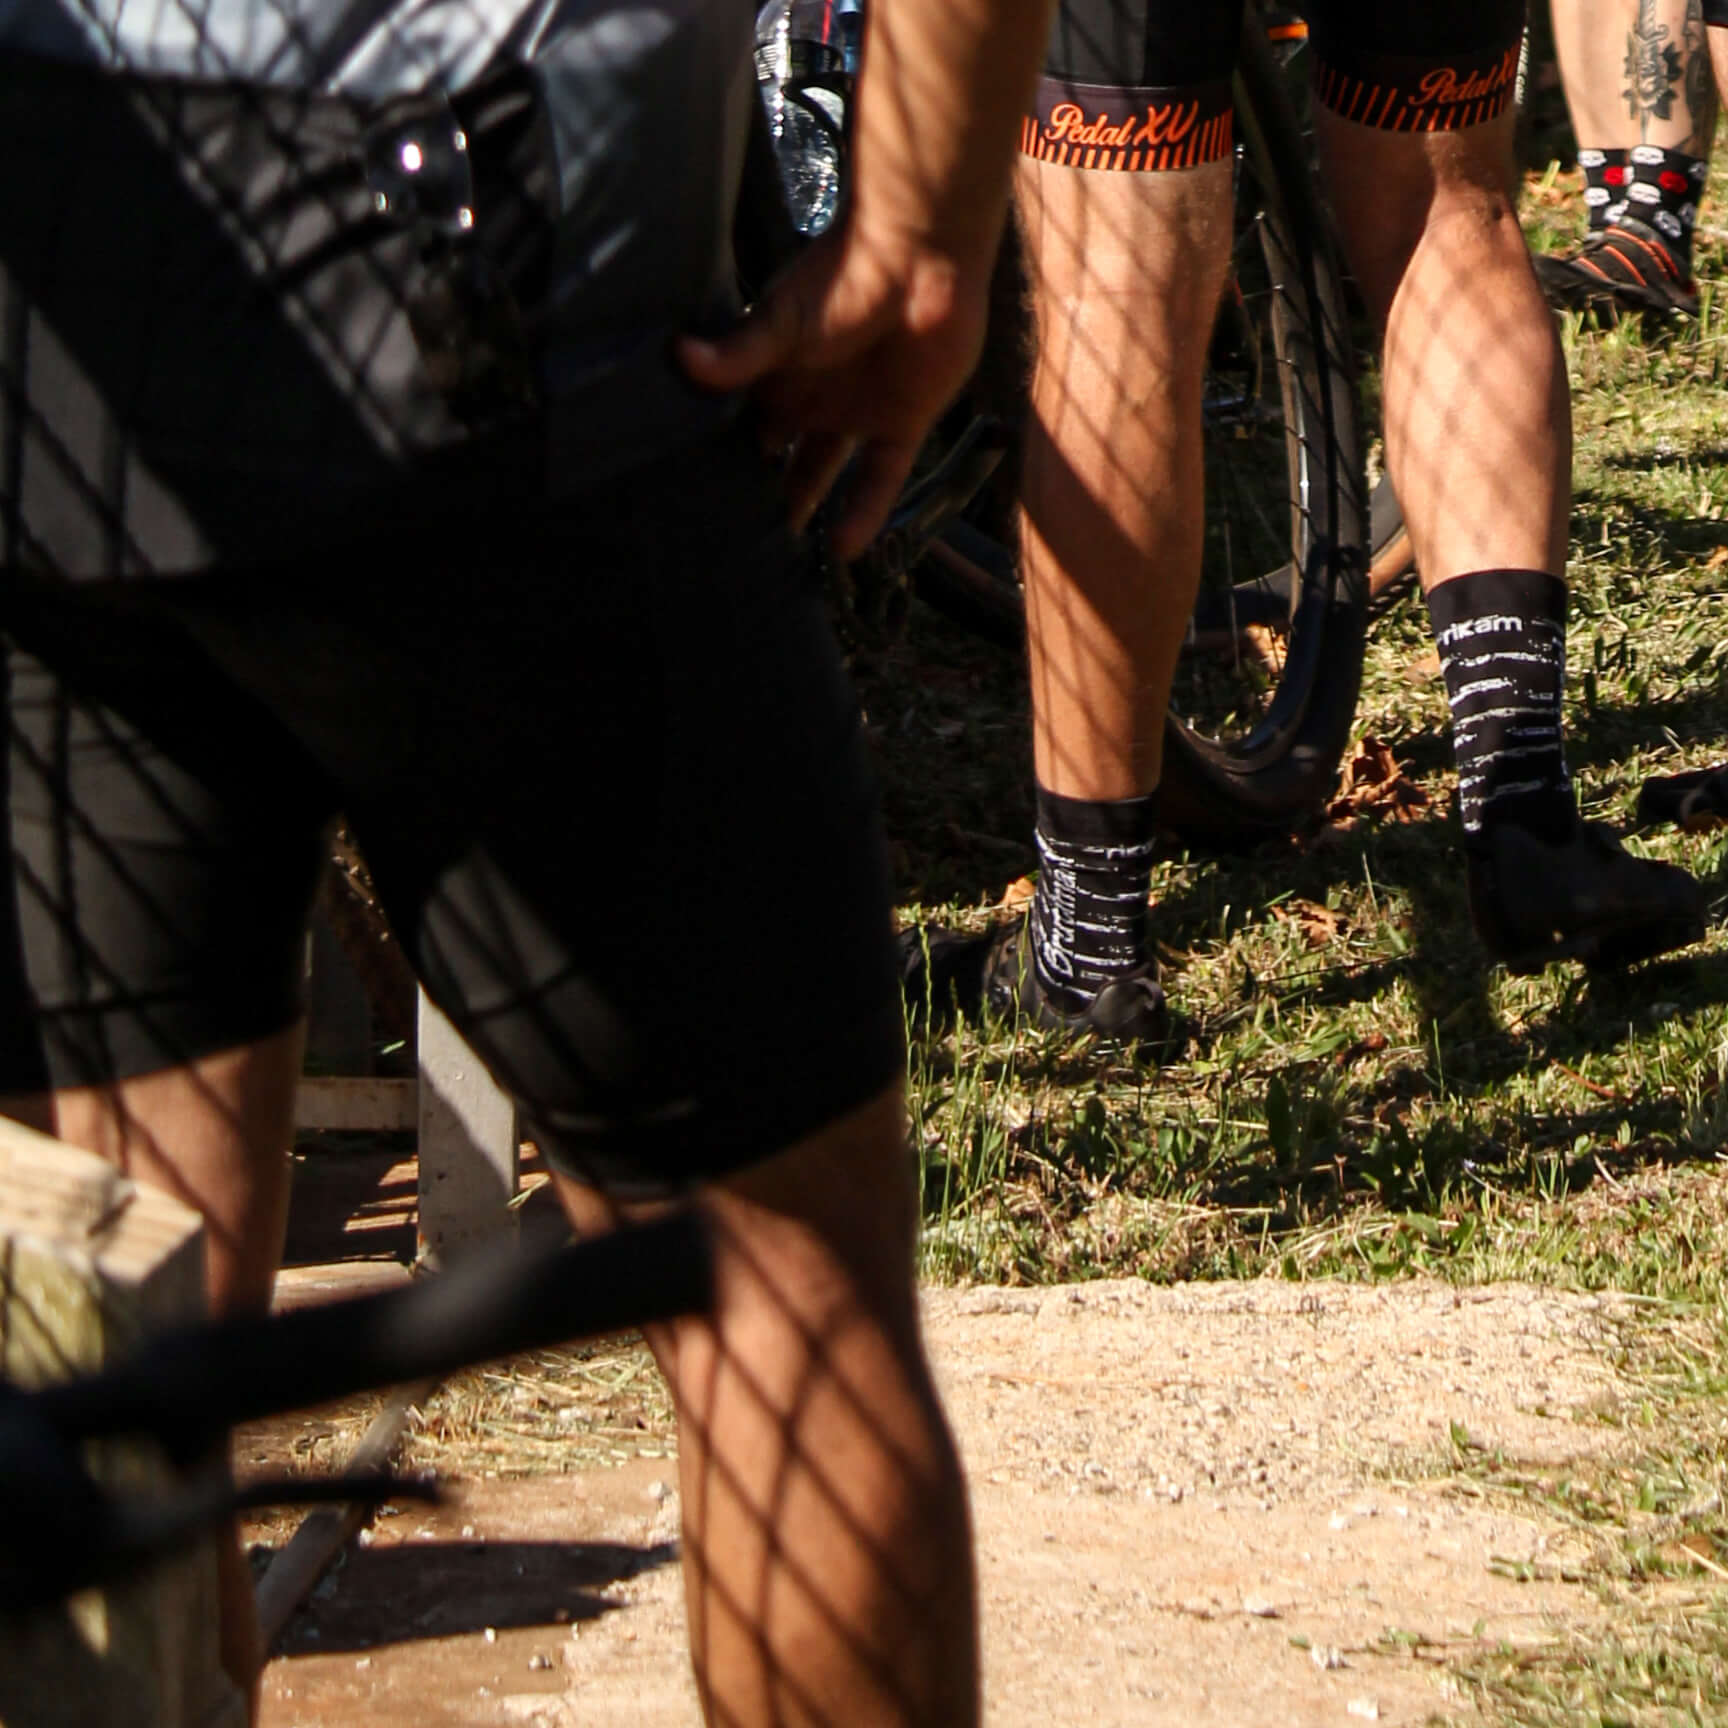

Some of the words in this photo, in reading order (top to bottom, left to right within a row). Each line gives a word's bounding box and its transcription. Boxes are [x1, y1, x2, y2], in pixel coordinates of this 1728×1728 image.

[1408, 66, 1498, 104] Pedal
[1045, 103, 1136, 147] Pedal
[1133, 99, 1199, 147] XV
